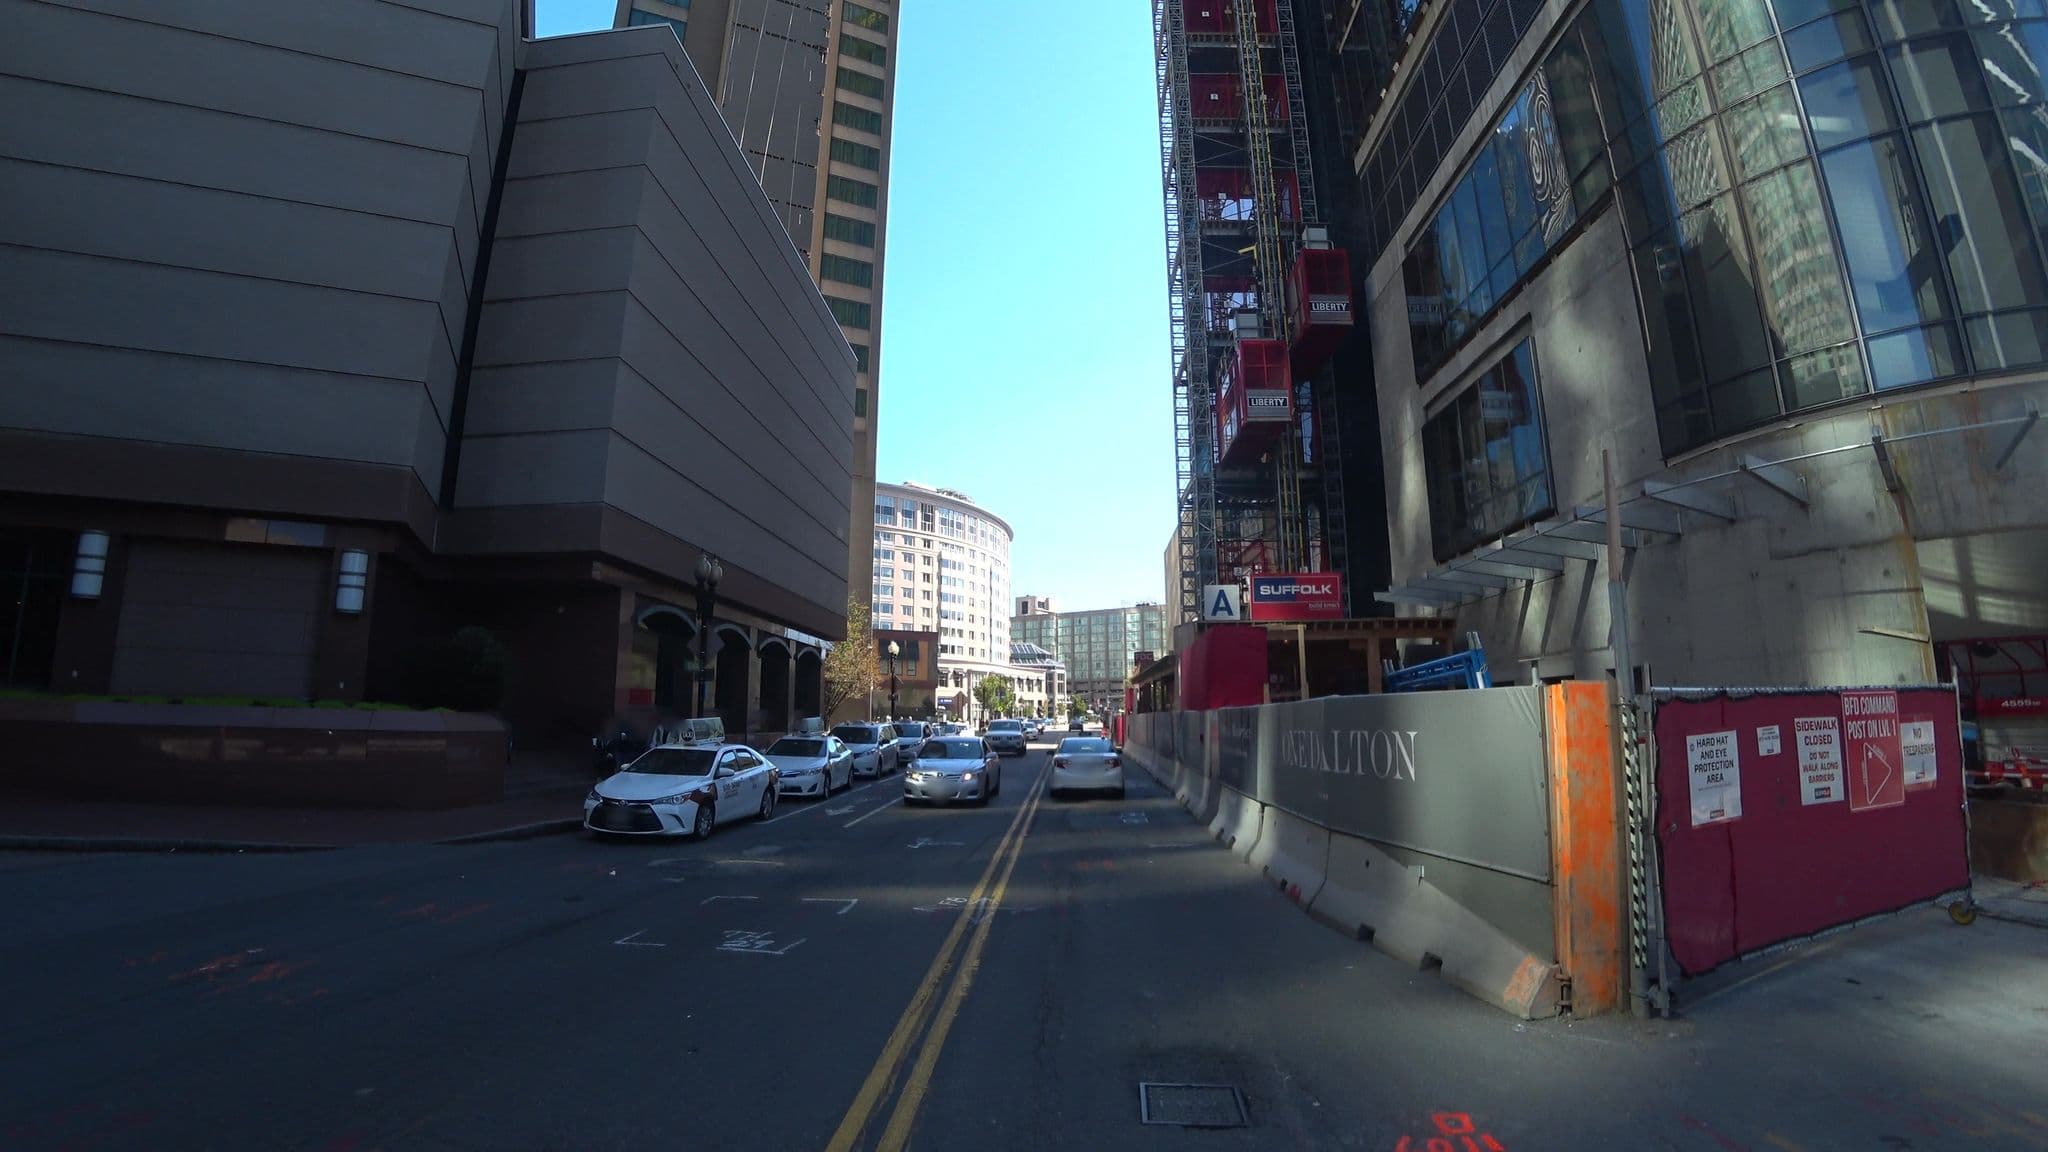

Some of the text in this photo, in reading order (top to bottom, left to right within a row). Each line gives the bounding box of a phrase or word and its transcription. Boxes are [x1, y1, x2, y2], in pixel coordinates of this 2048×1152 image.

[1311, 302, 1347, 311] LIBERTY
[1250, 398, 1285, 407] LIBERTY
[1260, 584, 1332, 595] SUFFOLK
[1211, 589, 1234, 616] A
[1860, 696, 1896, 714] COMMAND
[1795, 721, 1837, 731] SIDEWALK
[1847, 721, 1866, 740] POST
[1867, 720, 1879, 738] ON
[1696, 736, 1729, 748] HARD HAT
[1804, 735, 1833, 746] CLOSED
[1700, 748, 1727, 760] AND EYE
[1809, 751, 1830, 760] DO NOT
[1694, 760, 1734, 773] PROTECTION
[1802, 762, 1839, 773] WALK ALONG
[1706, 774, 1724, 784] AREA
[1808, 774, 1835, 783] BARRIERS
